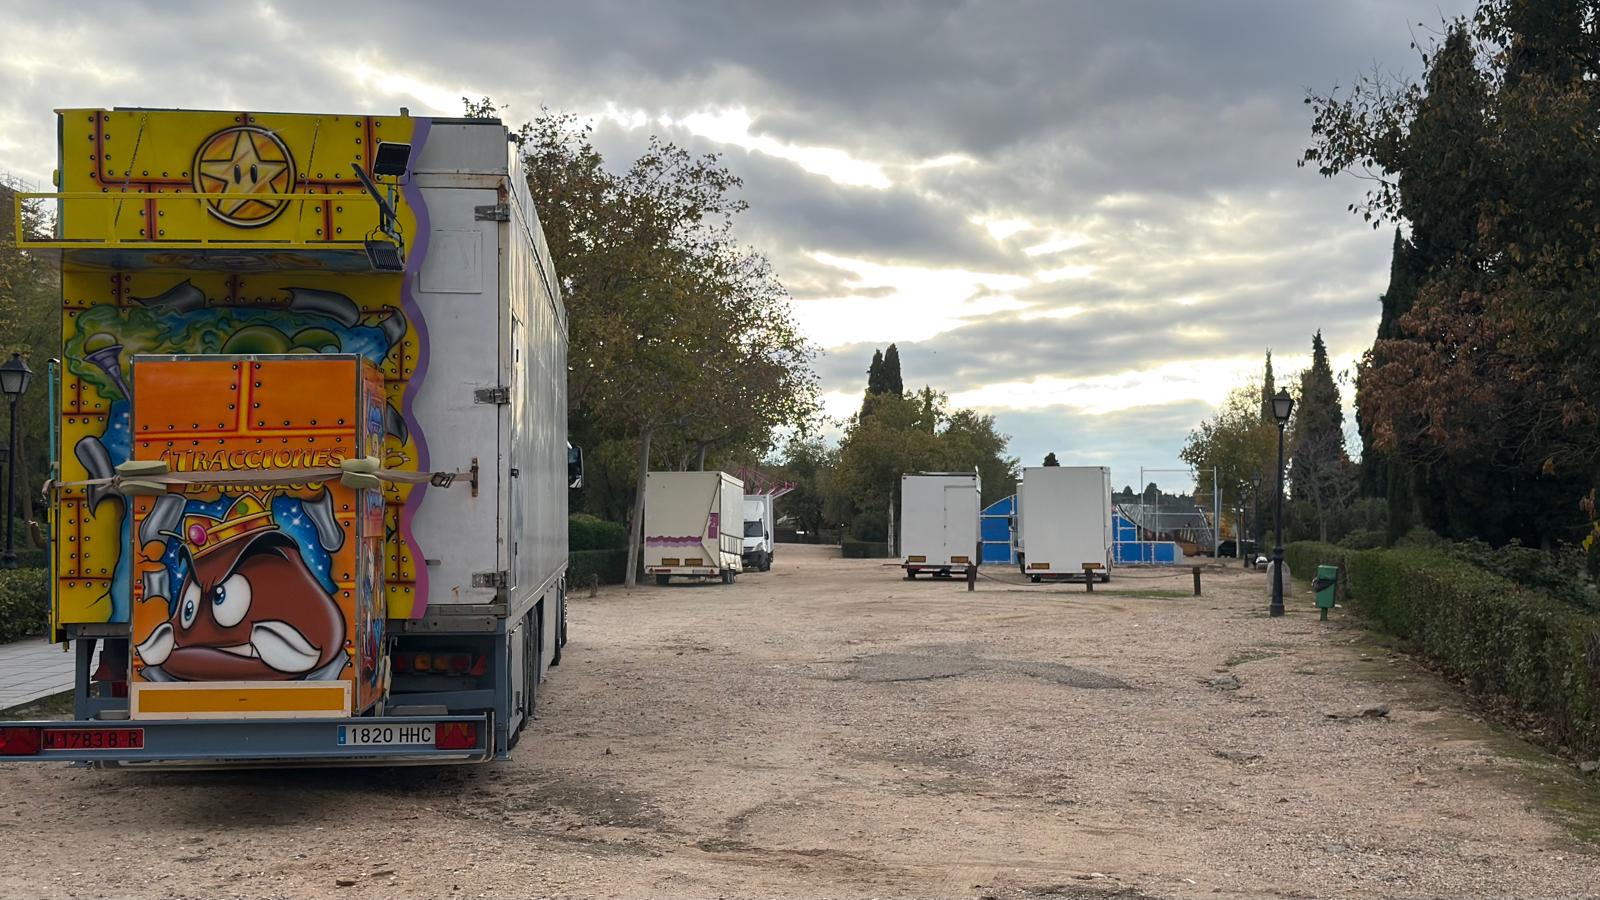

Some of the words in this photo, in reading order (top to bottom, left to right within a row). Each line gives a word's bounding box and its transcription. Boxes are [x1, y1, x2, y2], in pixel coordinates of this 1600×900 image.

[160, 447, 347, 473] ATRACCIONES
[351, 727, 393, 743] 1820
[399, 727, 431, 743] HHC
